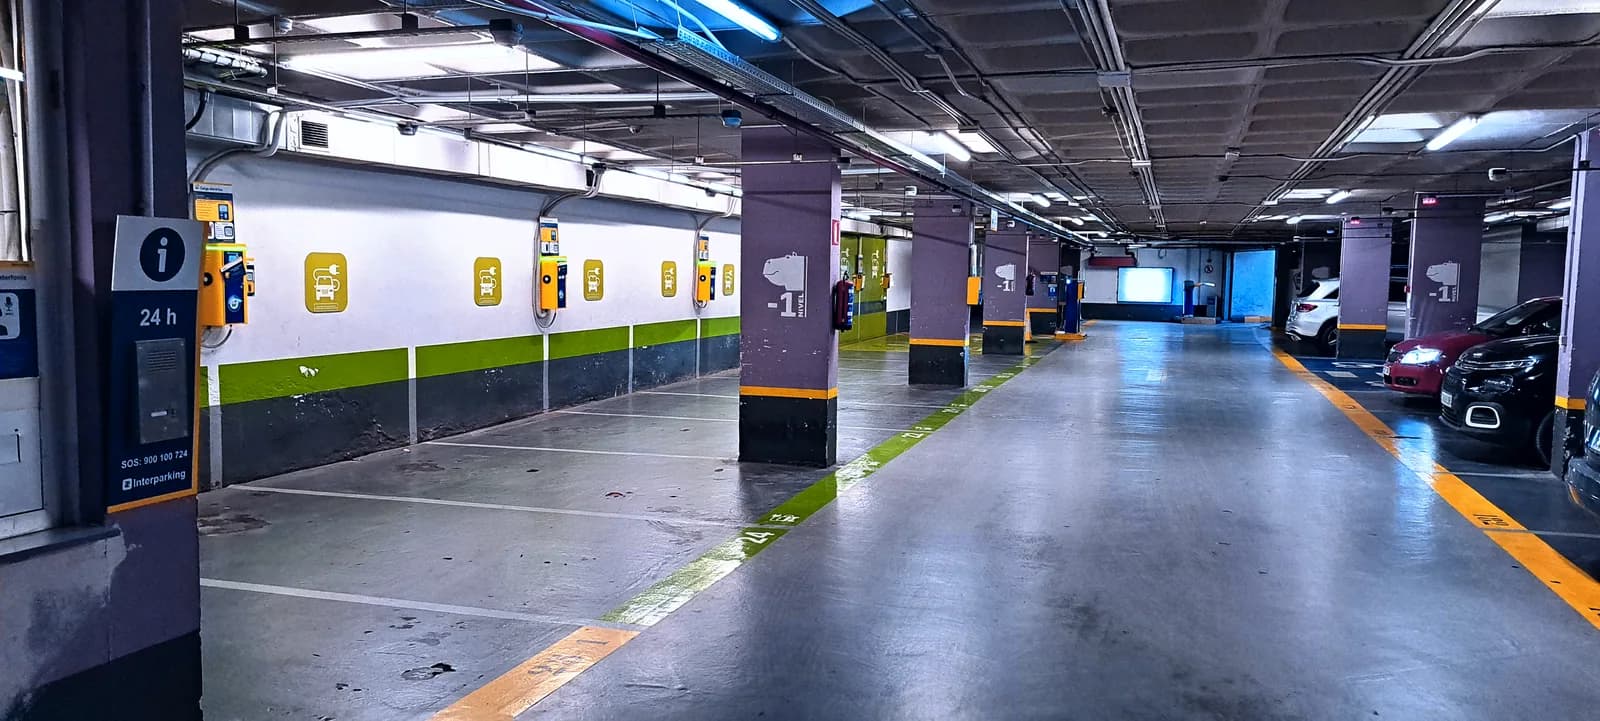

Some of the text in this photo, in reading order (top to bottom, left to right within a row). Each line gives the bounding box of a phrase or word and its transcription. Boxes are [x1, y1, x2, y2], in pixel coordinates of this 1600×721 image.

[996, 280, 1011, 292] -1
[1429, 286, 1451, 302] -1
[767, 292, 797, 318] -1
[797, 293, 805, 318] NIVEL
[139, 308, 177, 327] 24 h
[121, 449, 188, 469] SOS: 900 100 724
[133, 471, 186, 488] Interparking
[735, 532, 775, 544] 24
